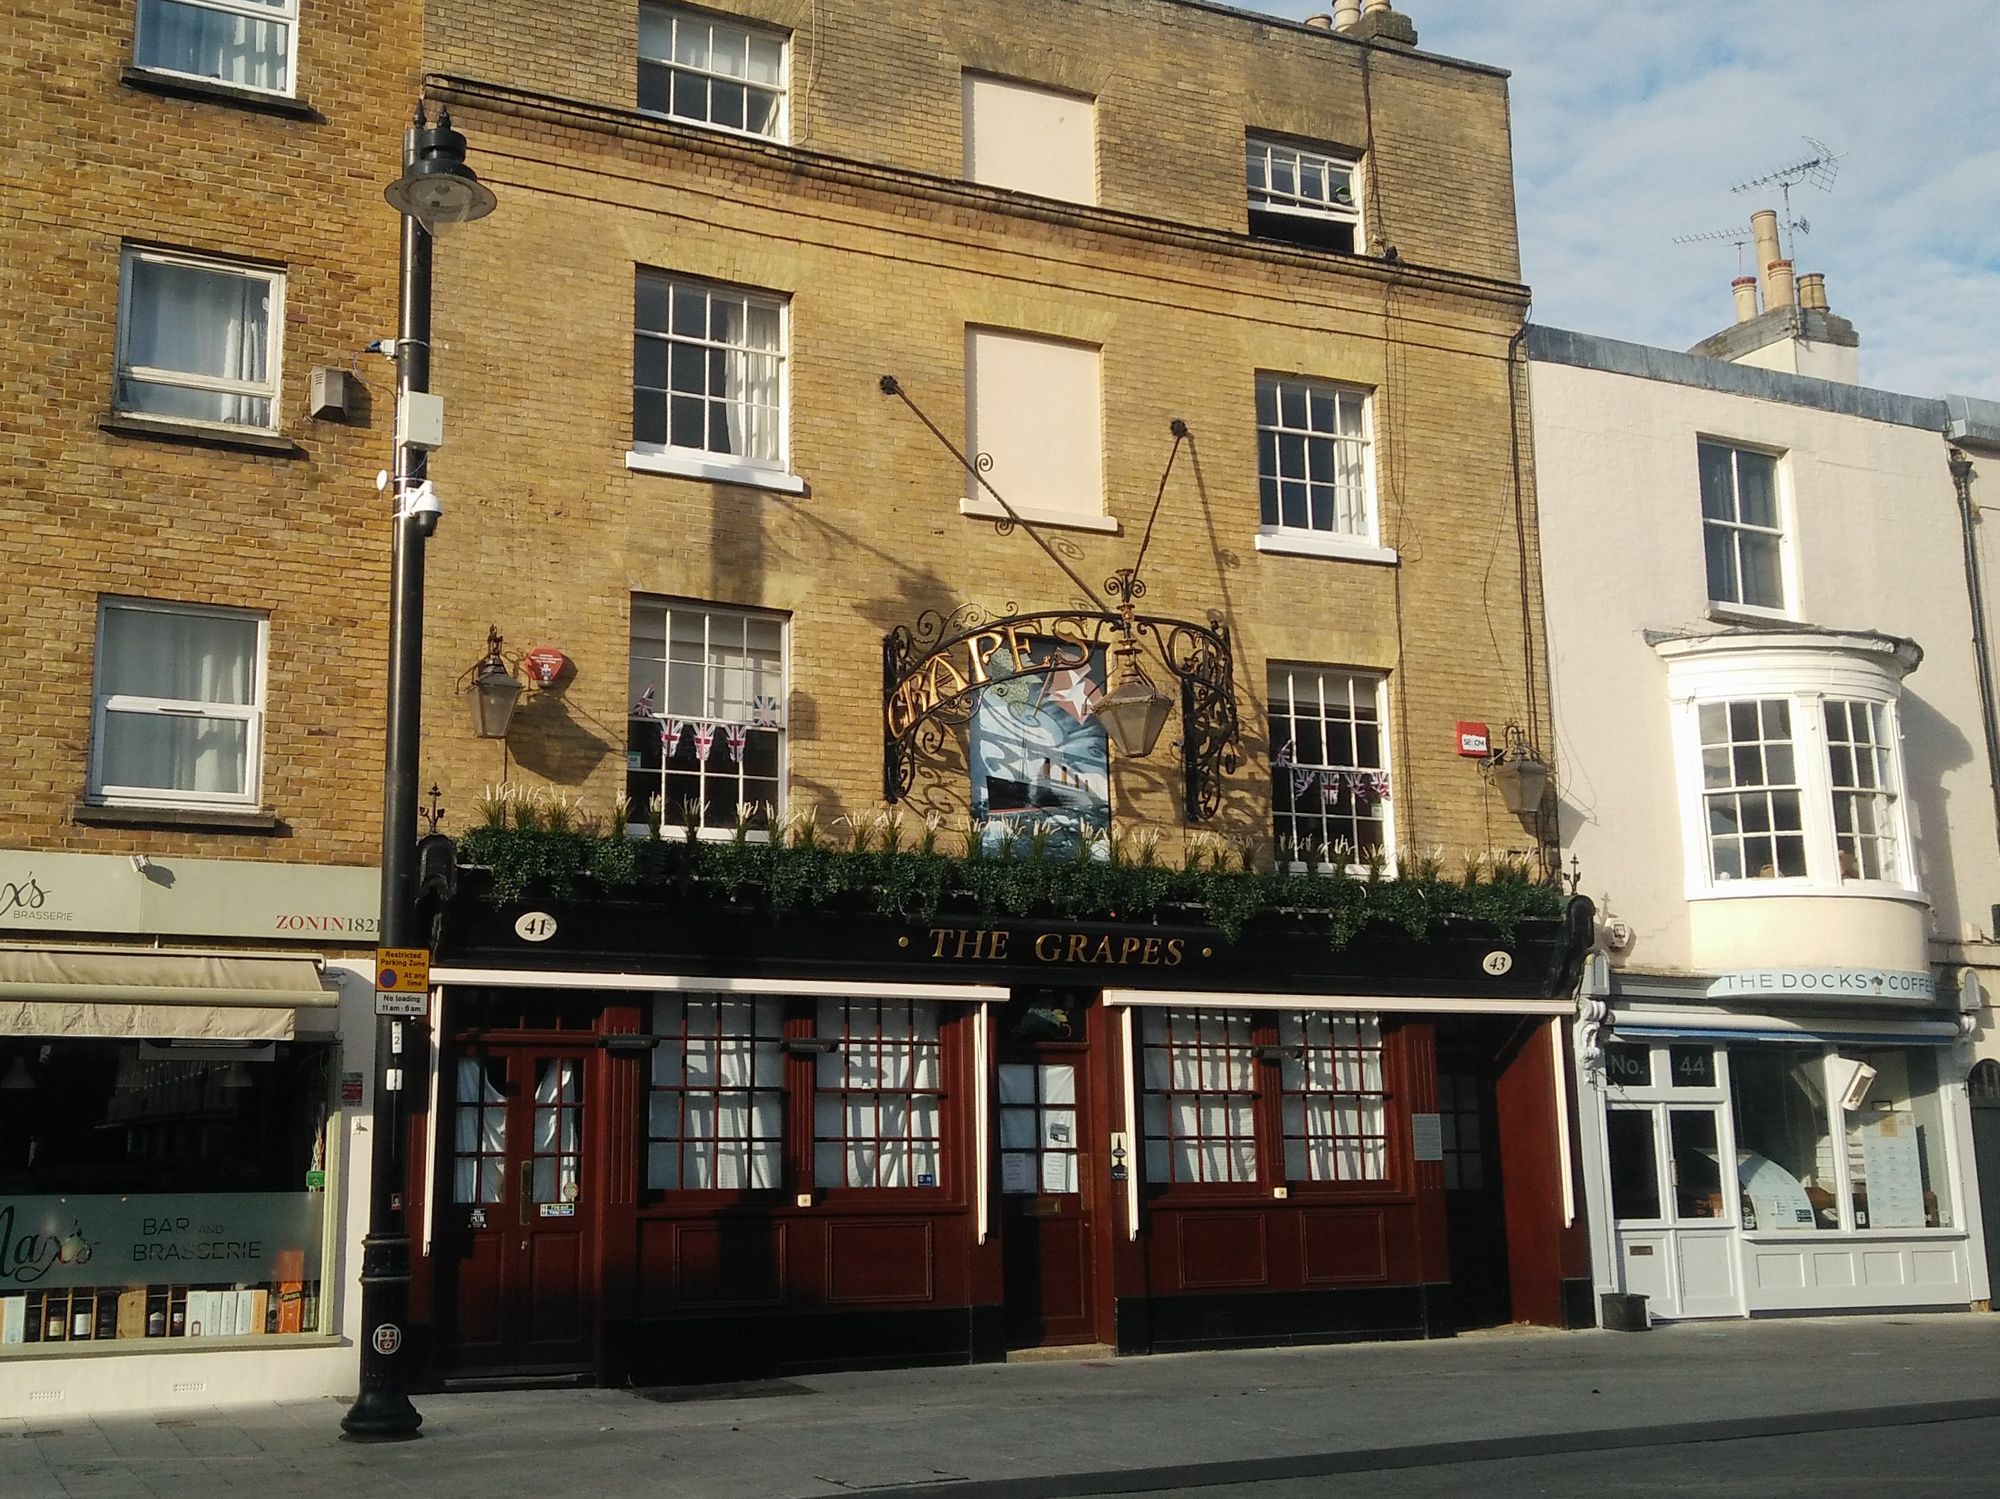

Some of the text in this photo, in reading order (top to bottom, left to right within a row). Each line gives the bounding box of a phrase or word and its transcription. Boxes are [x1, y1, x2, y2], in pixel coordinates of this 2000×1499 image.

[888, 616, 1090, 738] GRAPES
[13, 910, 73, 920] BRASSERIE
[524, 917, 546, 936] 41
[385, 950, 422, 959] Restricted
[929, 928, 1186, 966] THE GRAPES
[380, 959, 407, 967] Parking
[1489, 956, 1506, 971] 43
[1724, 974, 1773, 989] THE
[1782, 974, 1867, 988] DOCKS
[383, 994, 421, 1004] No loading
[394, 1036, 400, 1044] 2
[1610, 1054, 1705, 1076] No. 44
[142, 1217, 224, 1236] BAR AND
[132, 1241, 262, 1262] BRASSERIE
